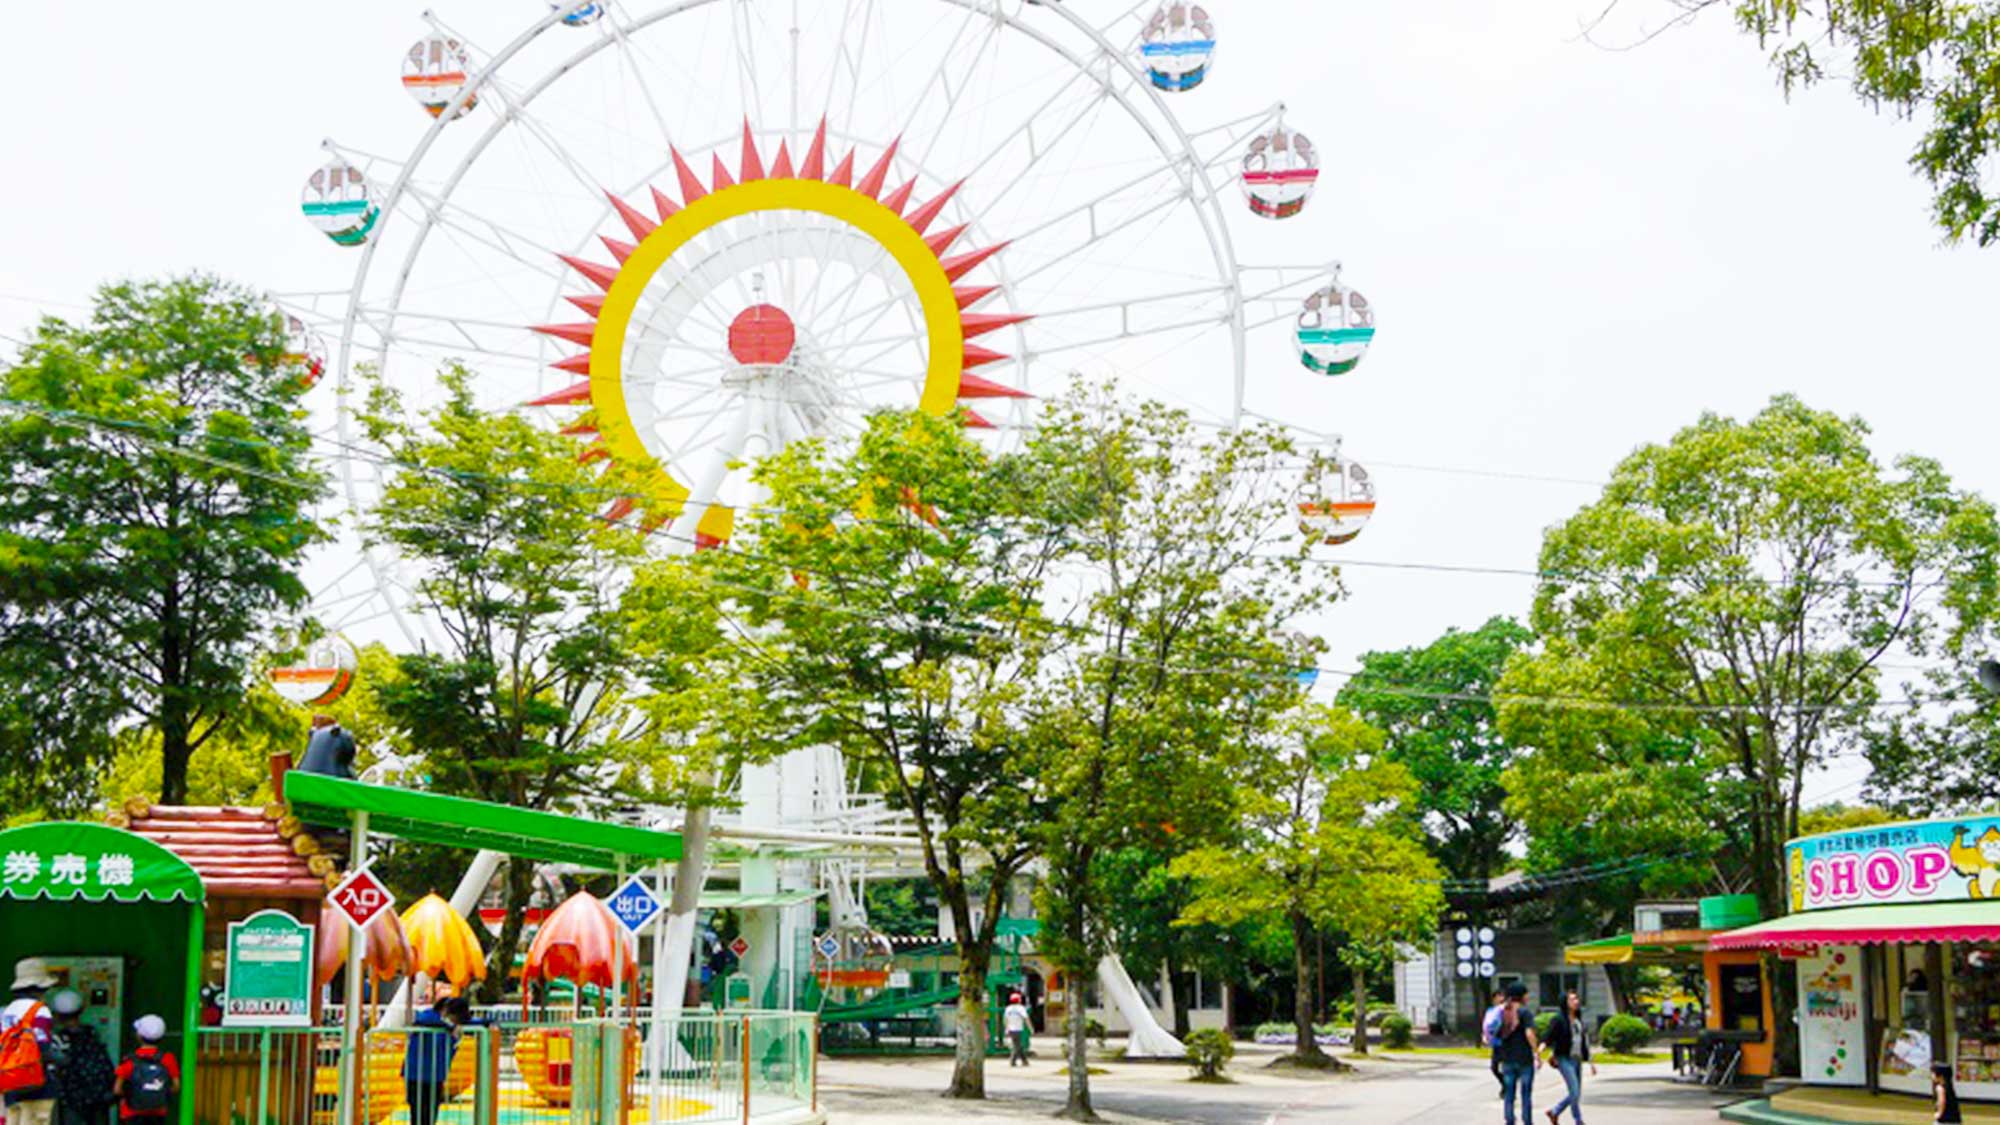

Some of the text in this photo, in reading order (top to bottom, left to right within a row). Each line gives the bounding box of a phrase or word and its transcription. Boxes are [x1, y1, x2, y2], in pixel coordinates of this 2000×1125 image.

[3, 850, 134, 886] 券売機
[1809, 852, 1947, 898] SHOP
[342, 888, 380, 906] 入口
[616, 896, 652, 913] 出口
[622, 913, 642, 921] OUT
